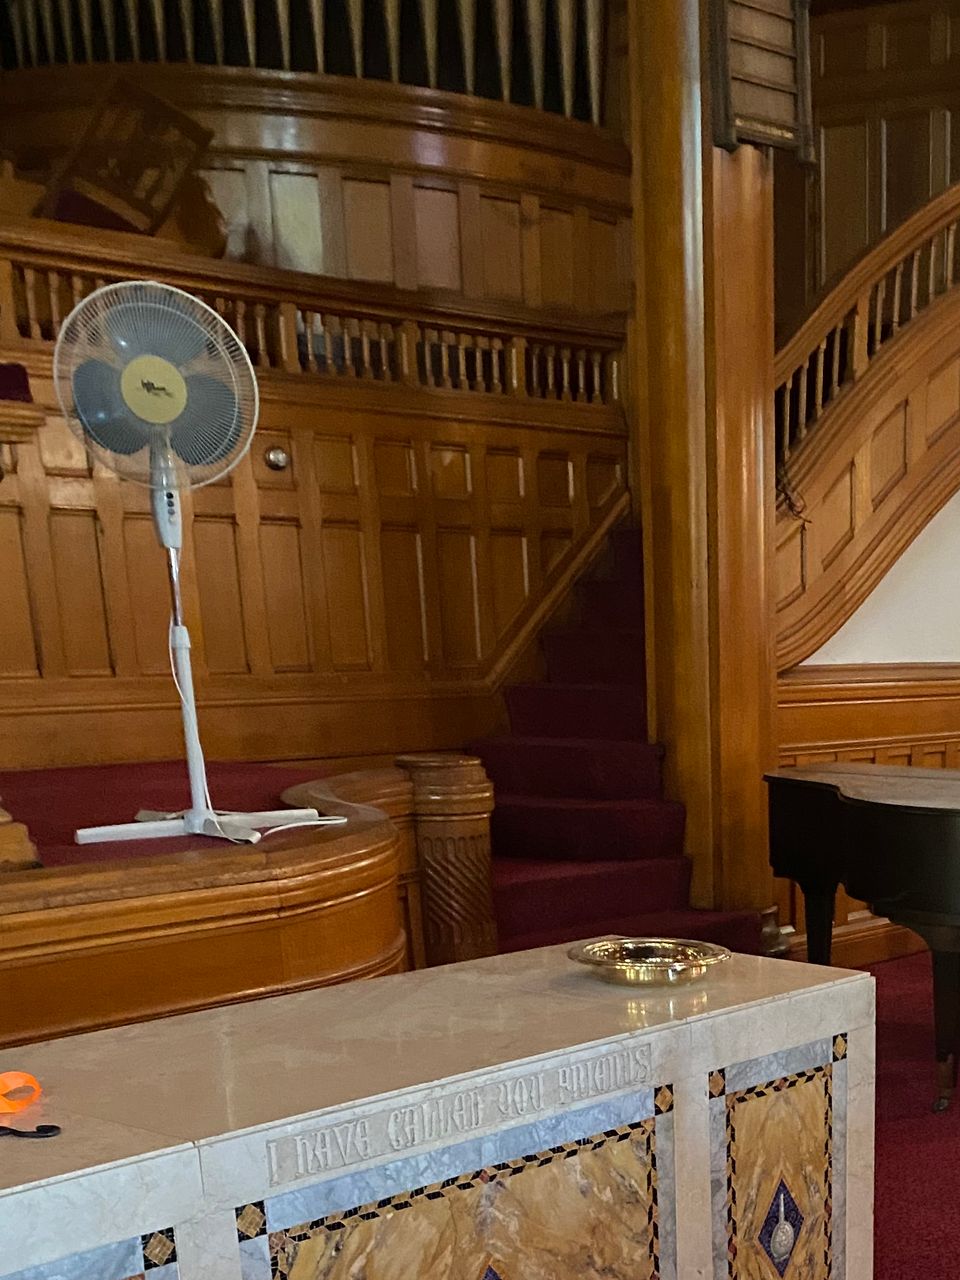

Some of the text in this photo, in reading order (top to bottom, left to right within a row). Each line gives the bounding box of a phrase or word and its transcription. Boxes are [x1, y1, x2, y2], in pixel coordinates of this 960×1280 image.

[268, 1142, 280, 1187] I
[387, 1090, 482, 1150] CALLED
[499, 1072, 545, 1117] YOU
[558, 1047, 651, 1104] FRIENDS
